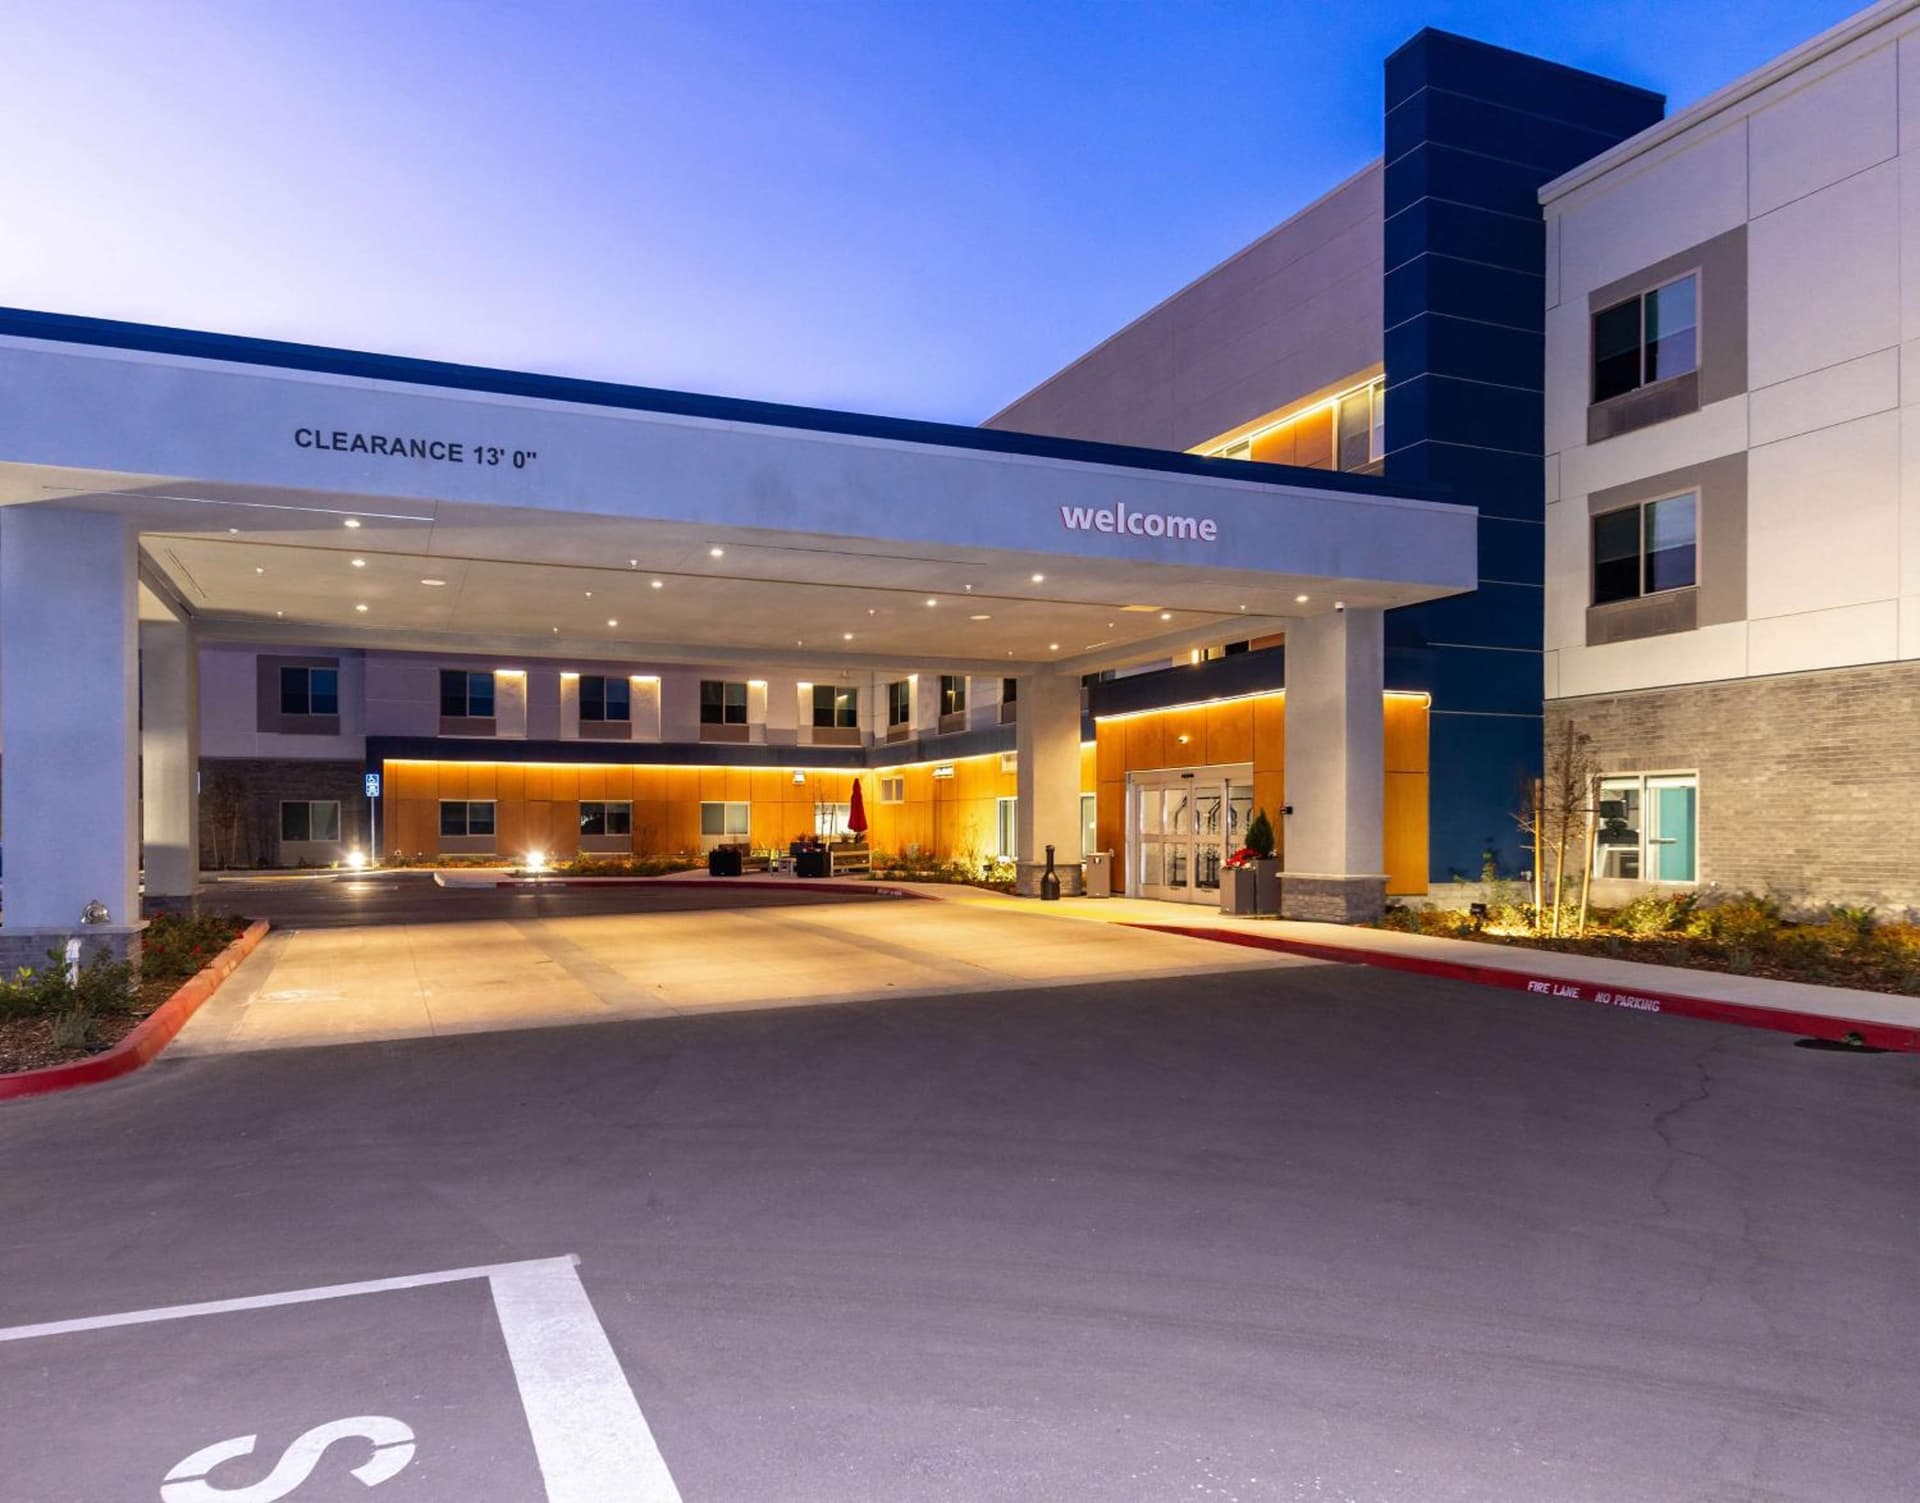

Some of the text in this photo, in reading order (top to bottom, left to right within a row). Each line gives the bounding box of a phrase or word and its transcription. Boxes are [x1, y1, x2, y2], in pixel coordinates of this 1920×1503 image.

[294, 428, 537, 469] CLEARANCE 13' 0"
[1060, 502, 1217, 541] welcome
[1527, 980, 1661, 1012] FIRE LANE NO PARKING
